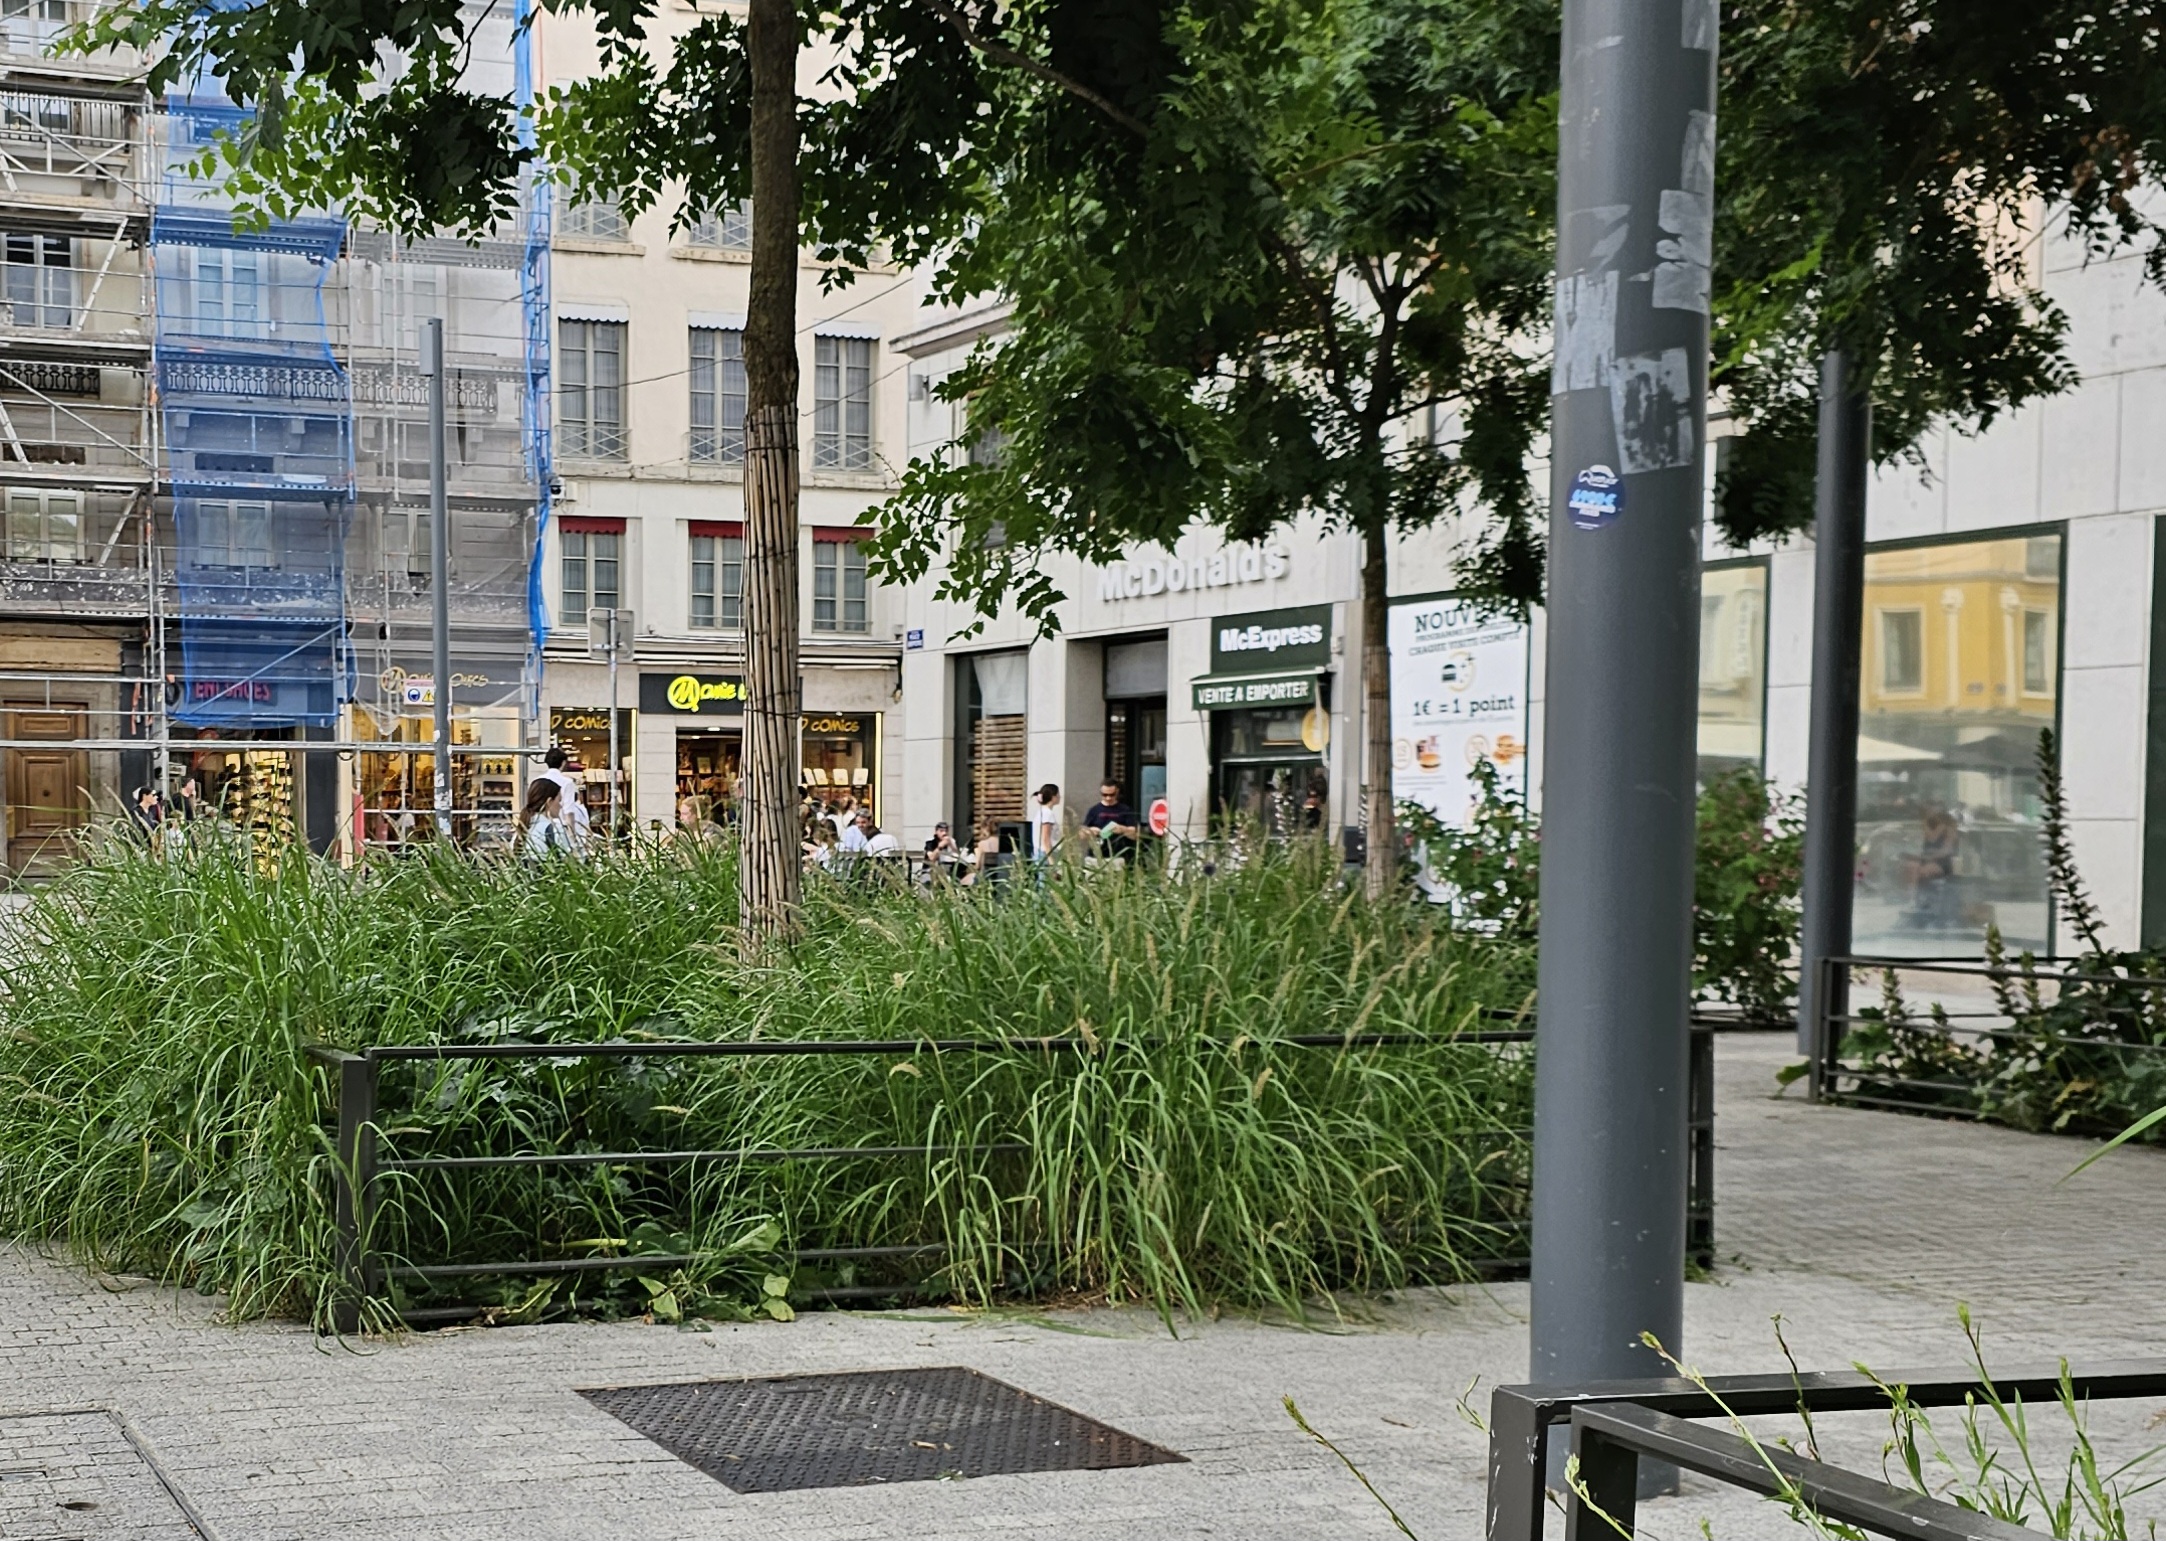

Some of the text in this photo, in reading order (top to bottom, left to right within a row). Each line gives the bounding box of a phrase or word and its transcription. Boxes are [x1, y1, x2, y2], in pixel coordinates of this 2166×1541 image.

[1220, 624, 1323, 652] McExpress
[1198, 681, 1309, 704] VENTE A EMPORTER
[1469, 694, 1515, 718] point
